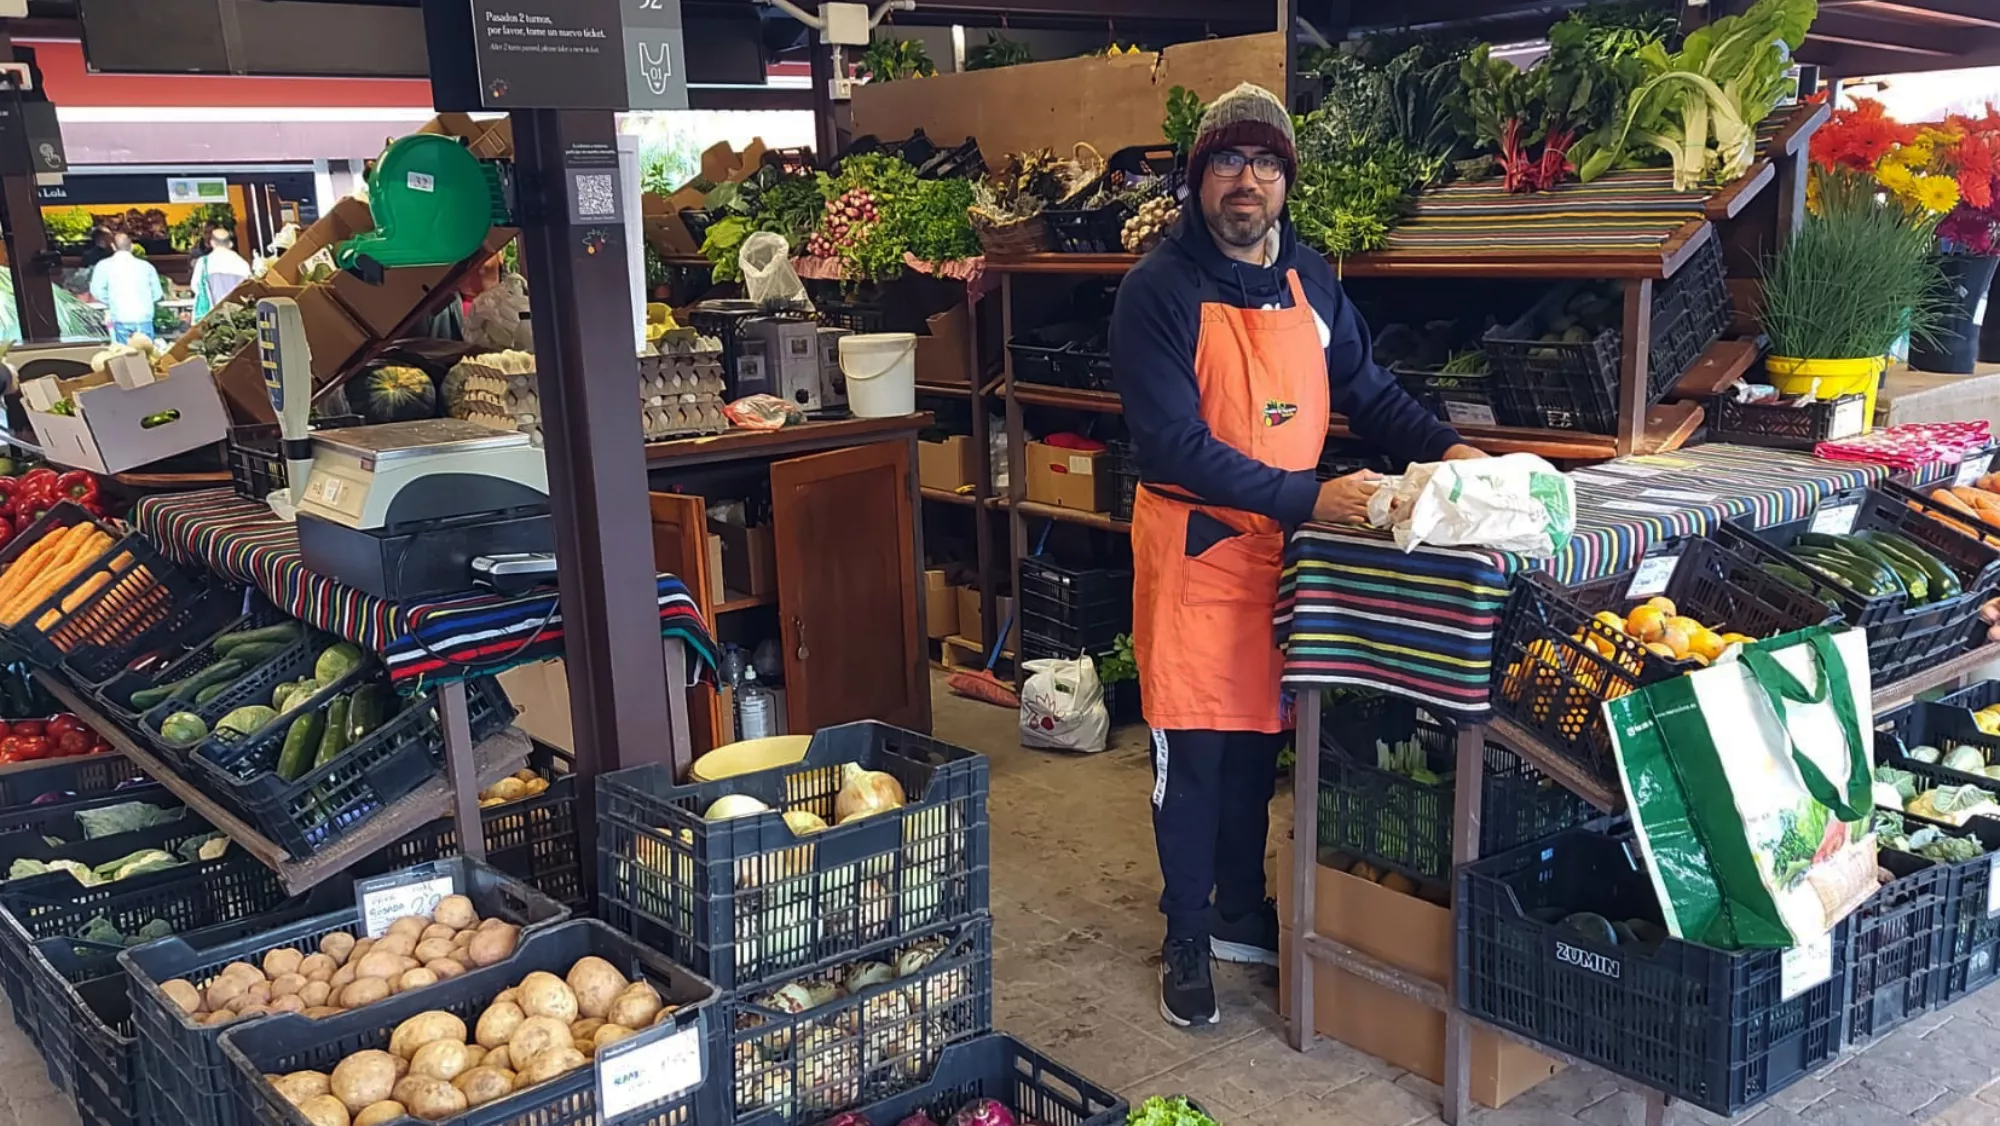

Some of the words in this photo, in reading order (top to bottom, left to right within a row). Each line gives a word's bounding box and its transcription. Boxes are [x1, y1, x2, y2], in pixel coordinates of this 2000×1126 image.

[485, 11, 518, 22] Pasados
[518, 12, 525, 23] 2
[525, 13, 552, 25] turnos,
[487, 26, 501, 37] por
[502, 25, 526, 37] favor,
[526, 27, 546, 37] tome
[547, 28, 558, 37] un
[559, 29, 582, 38] nuevo
[583, 27, 606, 39] ticket.
[650, 67, 662, 80] 01
[43, 187, 68, 198] Lola
[1556, 941, 1620, 978] ZUMIN
